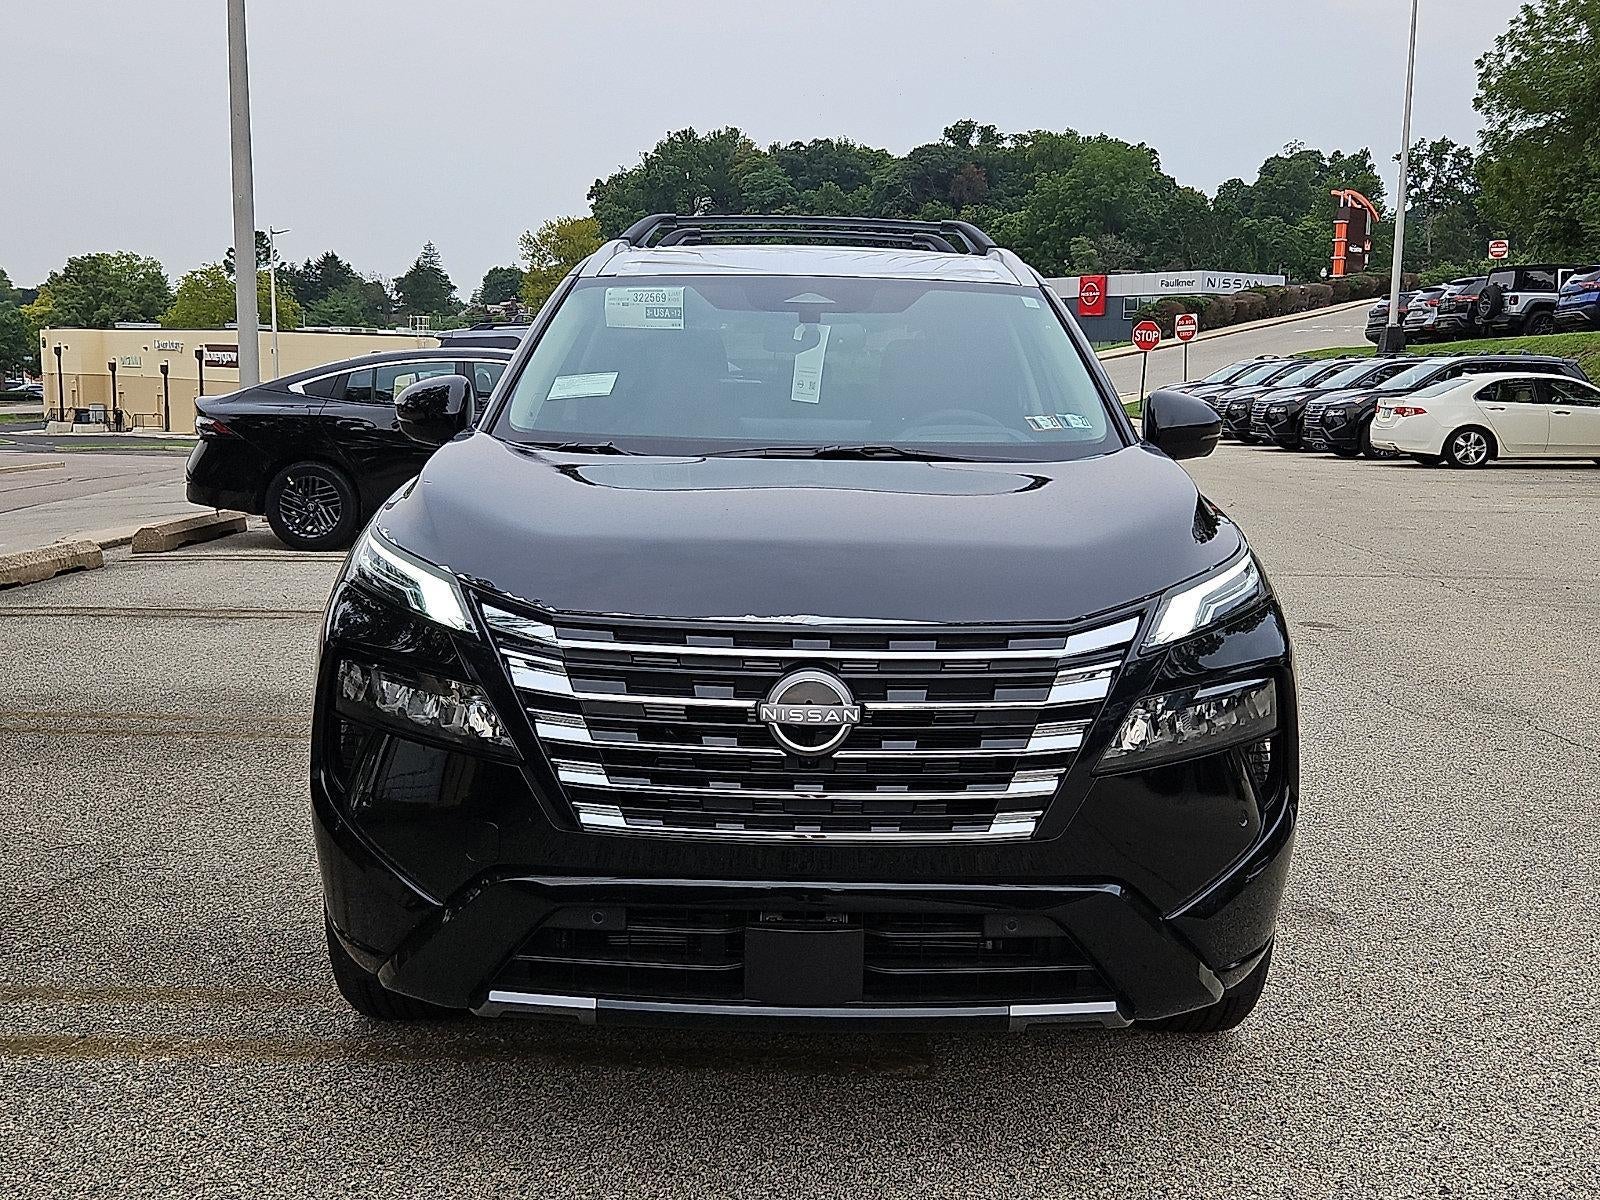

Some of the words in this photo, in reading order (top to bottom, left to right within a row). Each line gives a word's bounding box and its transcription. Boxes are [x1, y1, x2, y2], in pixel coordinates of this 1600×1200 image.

[1160, 279, 1196, 288] Faulkner
[632, 292, 667, 303] 322569
[653, 308, 671, 318] USA
[1134, 330, 1159, 343] STOP
[762, 707, 859, 723] NISSAN
